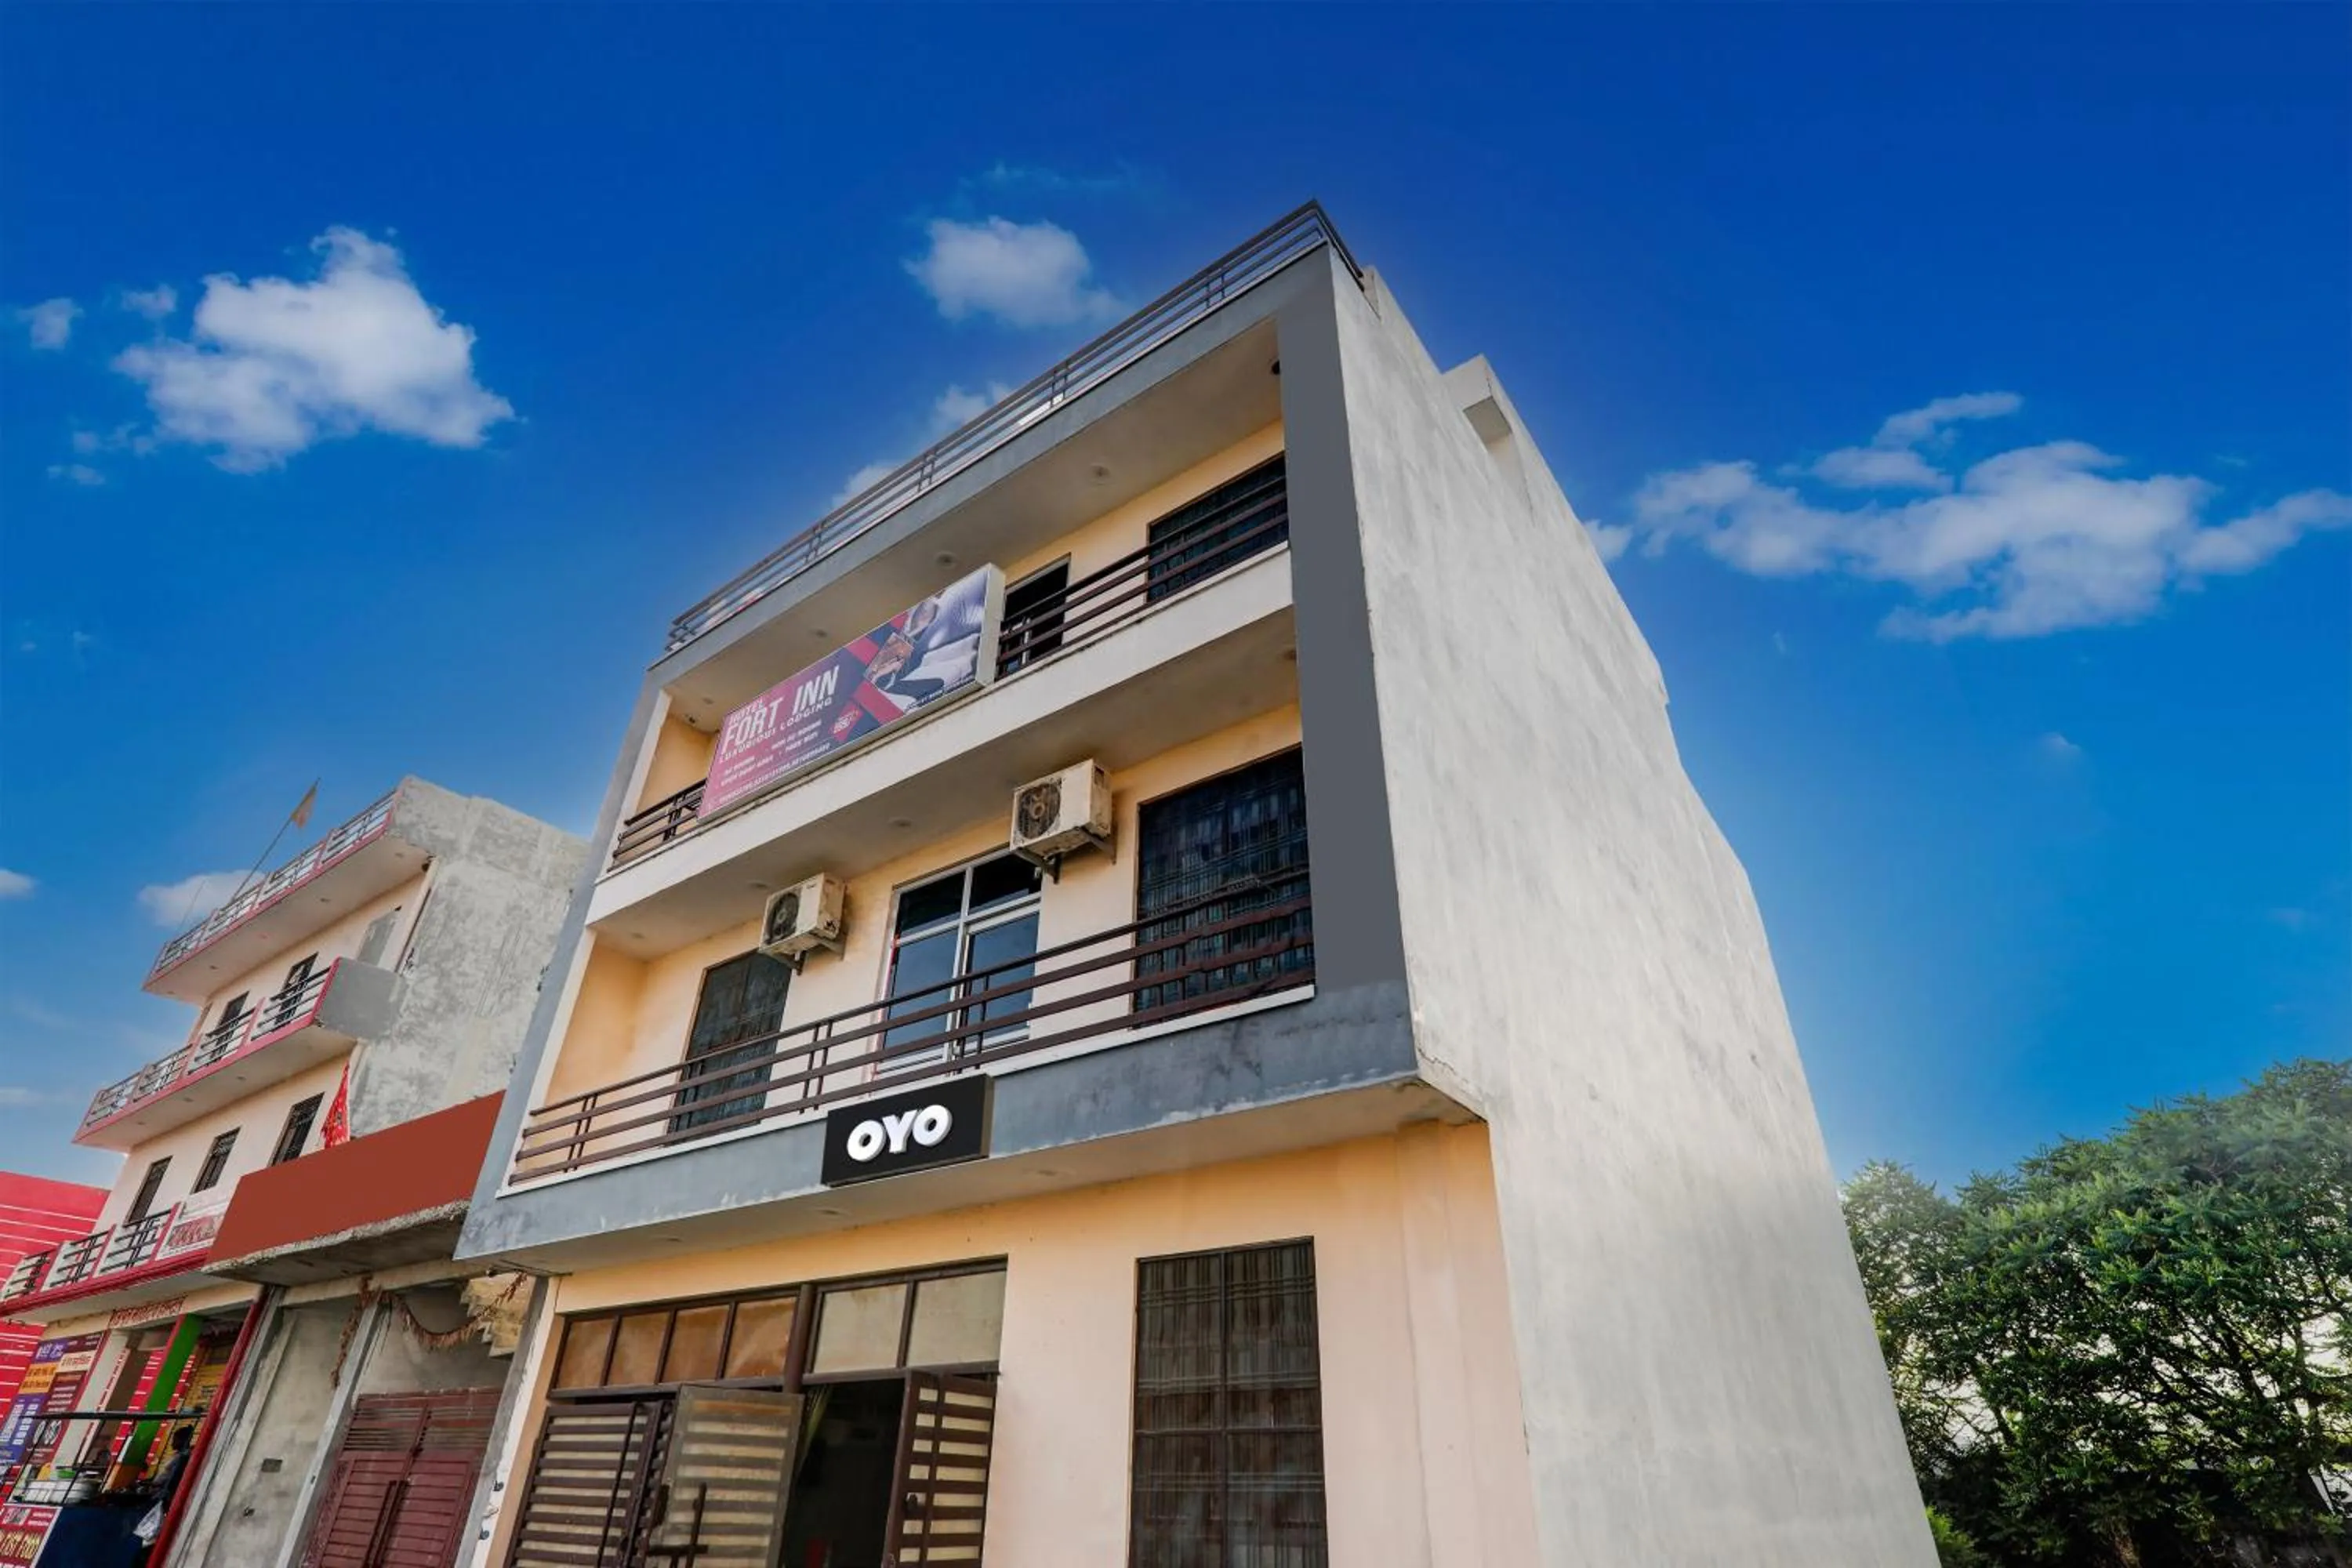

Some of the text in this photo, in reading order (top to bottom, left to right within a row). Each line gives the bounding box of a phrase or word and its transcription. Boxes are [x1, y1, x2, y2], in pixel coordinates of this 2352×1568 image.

[721, 697, 783, 753] FORT
[792, 665, 839, 715] INN
[847, 1104, 953, 1162] OYO
